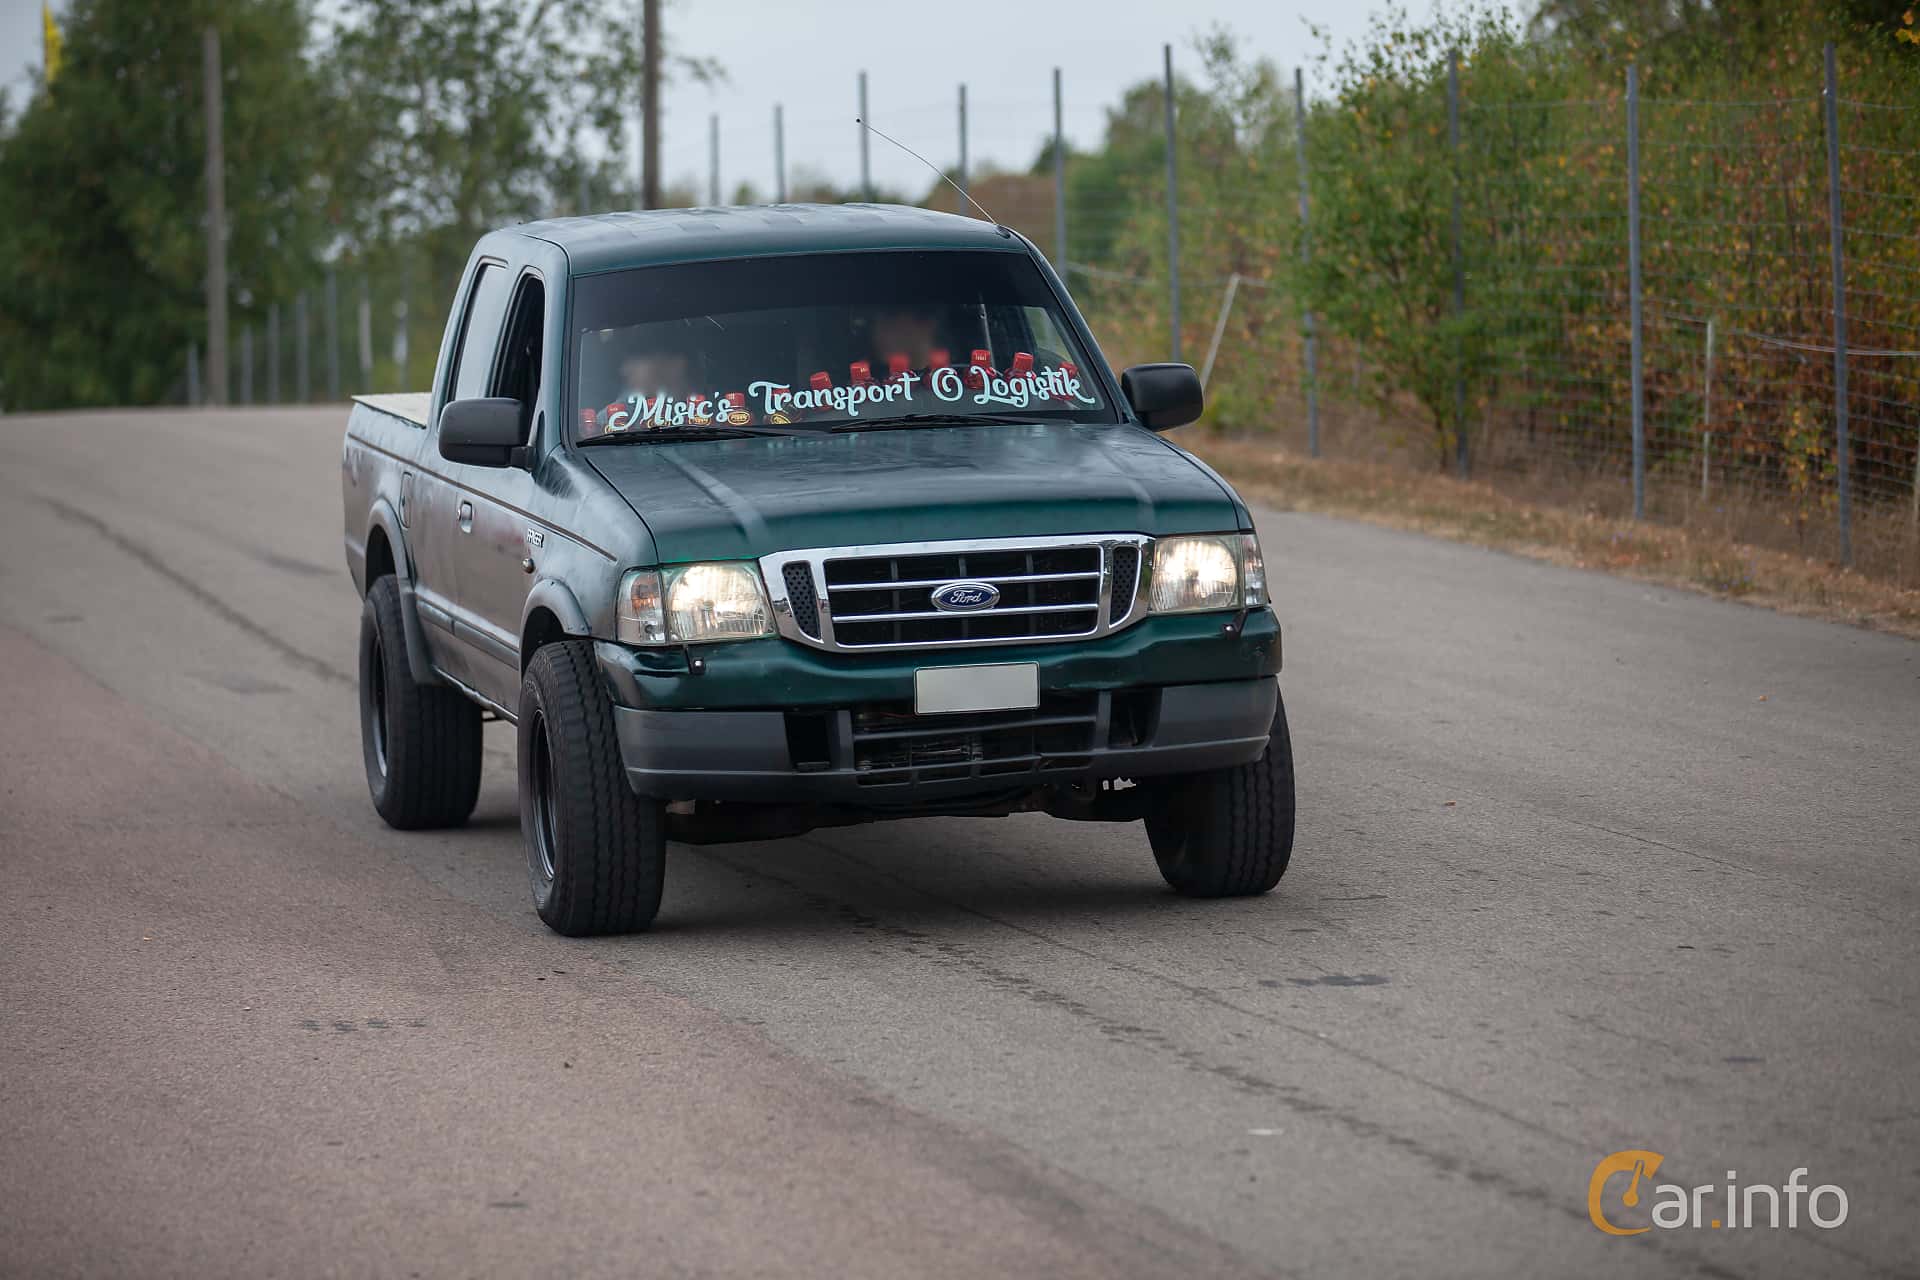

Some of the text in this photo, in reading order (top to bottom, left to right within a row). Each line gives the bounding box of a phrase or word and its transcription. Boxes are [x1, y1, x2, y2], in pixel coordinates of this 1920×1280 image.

[609, 391, 733, 431] Misic's
[748, 371, 920, 417] Transport
[970, 364, 1096, 408] Logistik
[950, 589, 982, 604] Ford
